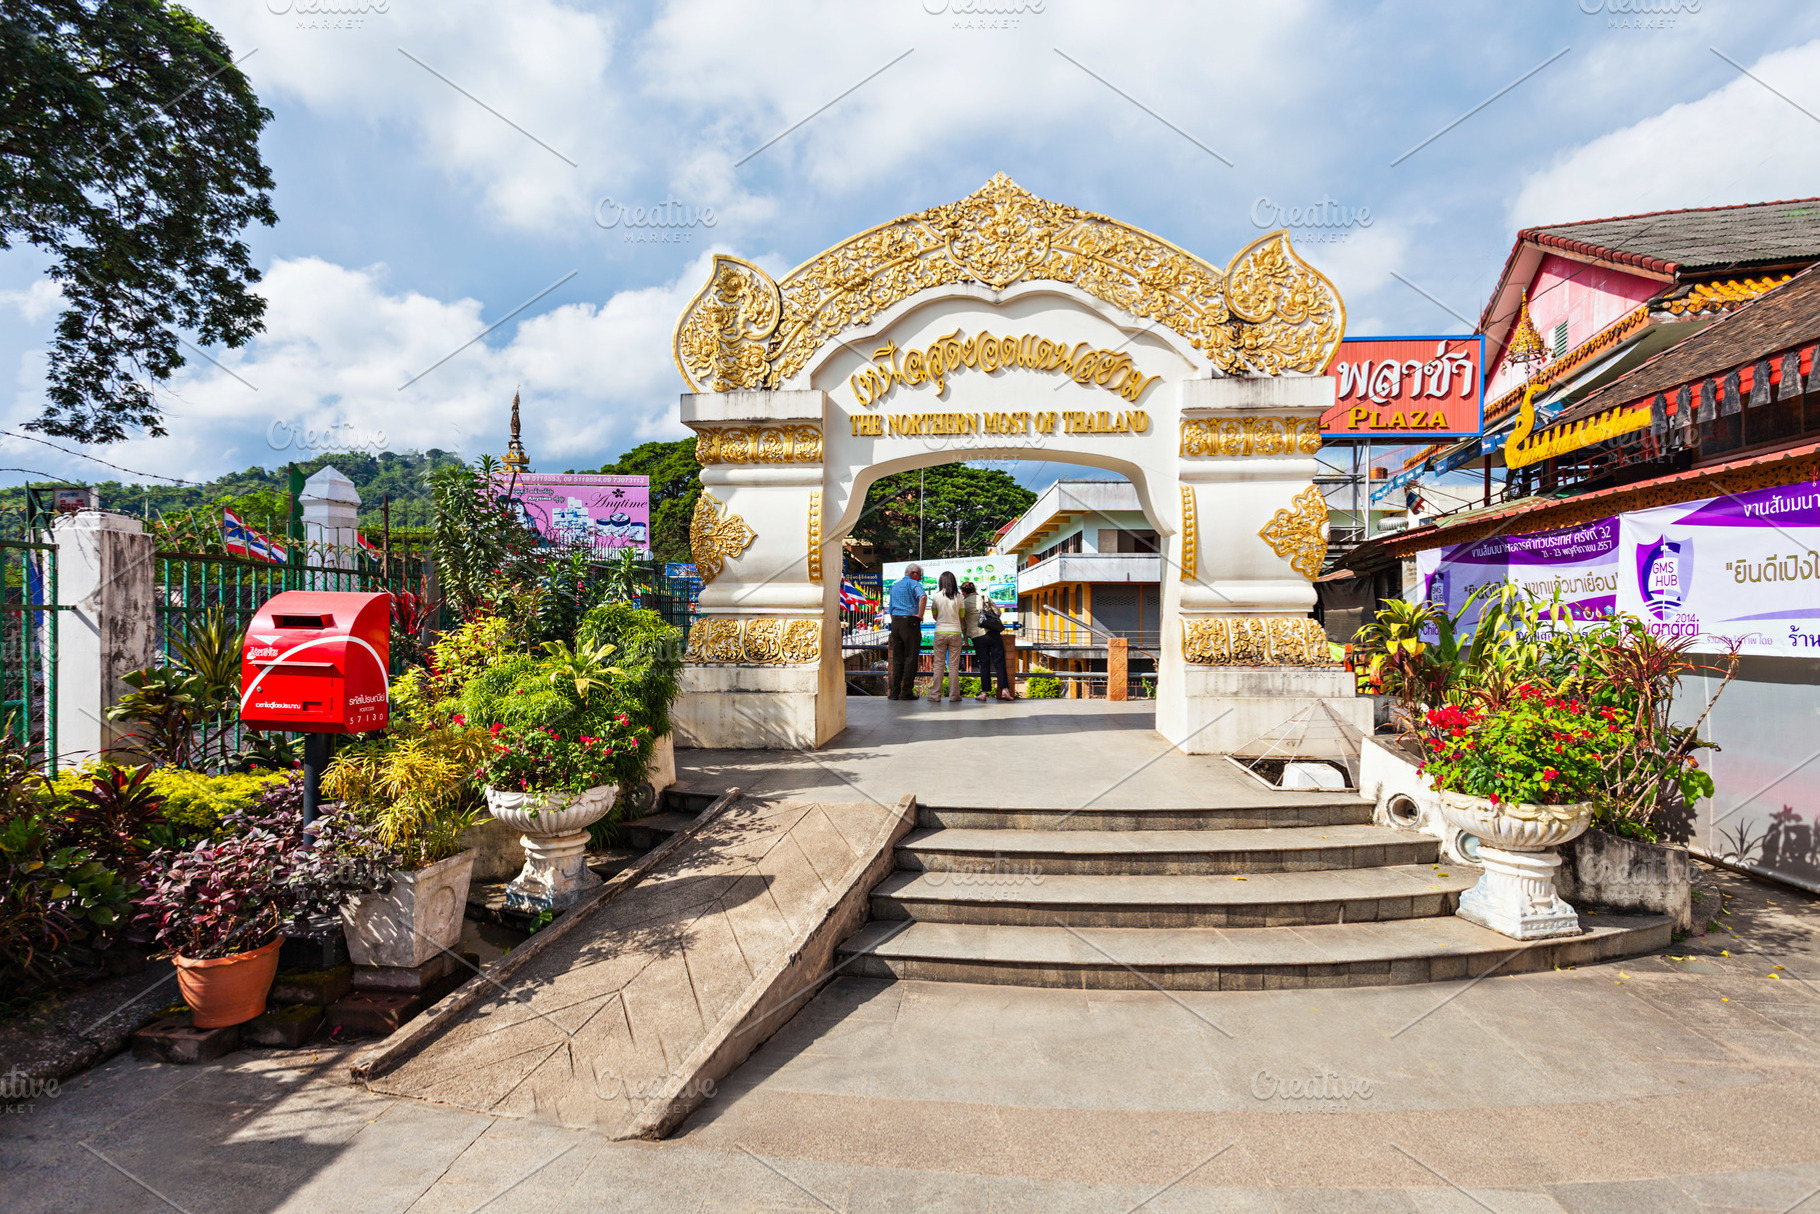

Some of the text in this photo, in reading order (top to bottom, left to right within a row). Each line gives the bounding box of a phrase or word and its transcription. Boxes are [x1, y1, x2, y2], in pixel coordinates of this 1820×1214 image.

[1336, 339, 1474, 404] พลาซ่า
[850, 410, 1150, 436] THE NORTHERN MOST OF THAILAND
[1348, 407, 1450, 429] PLAZA
[585, 492, 648, 513] Anytime
[1599, 525, 1611, 540] 32
[1652, 561, 1675, 575] GMS
[1655, 575, 1678, 588] HUB
[1675, 613, 1696, 623] 2014
[1624, 619, 1700, 639] Ciangrai
